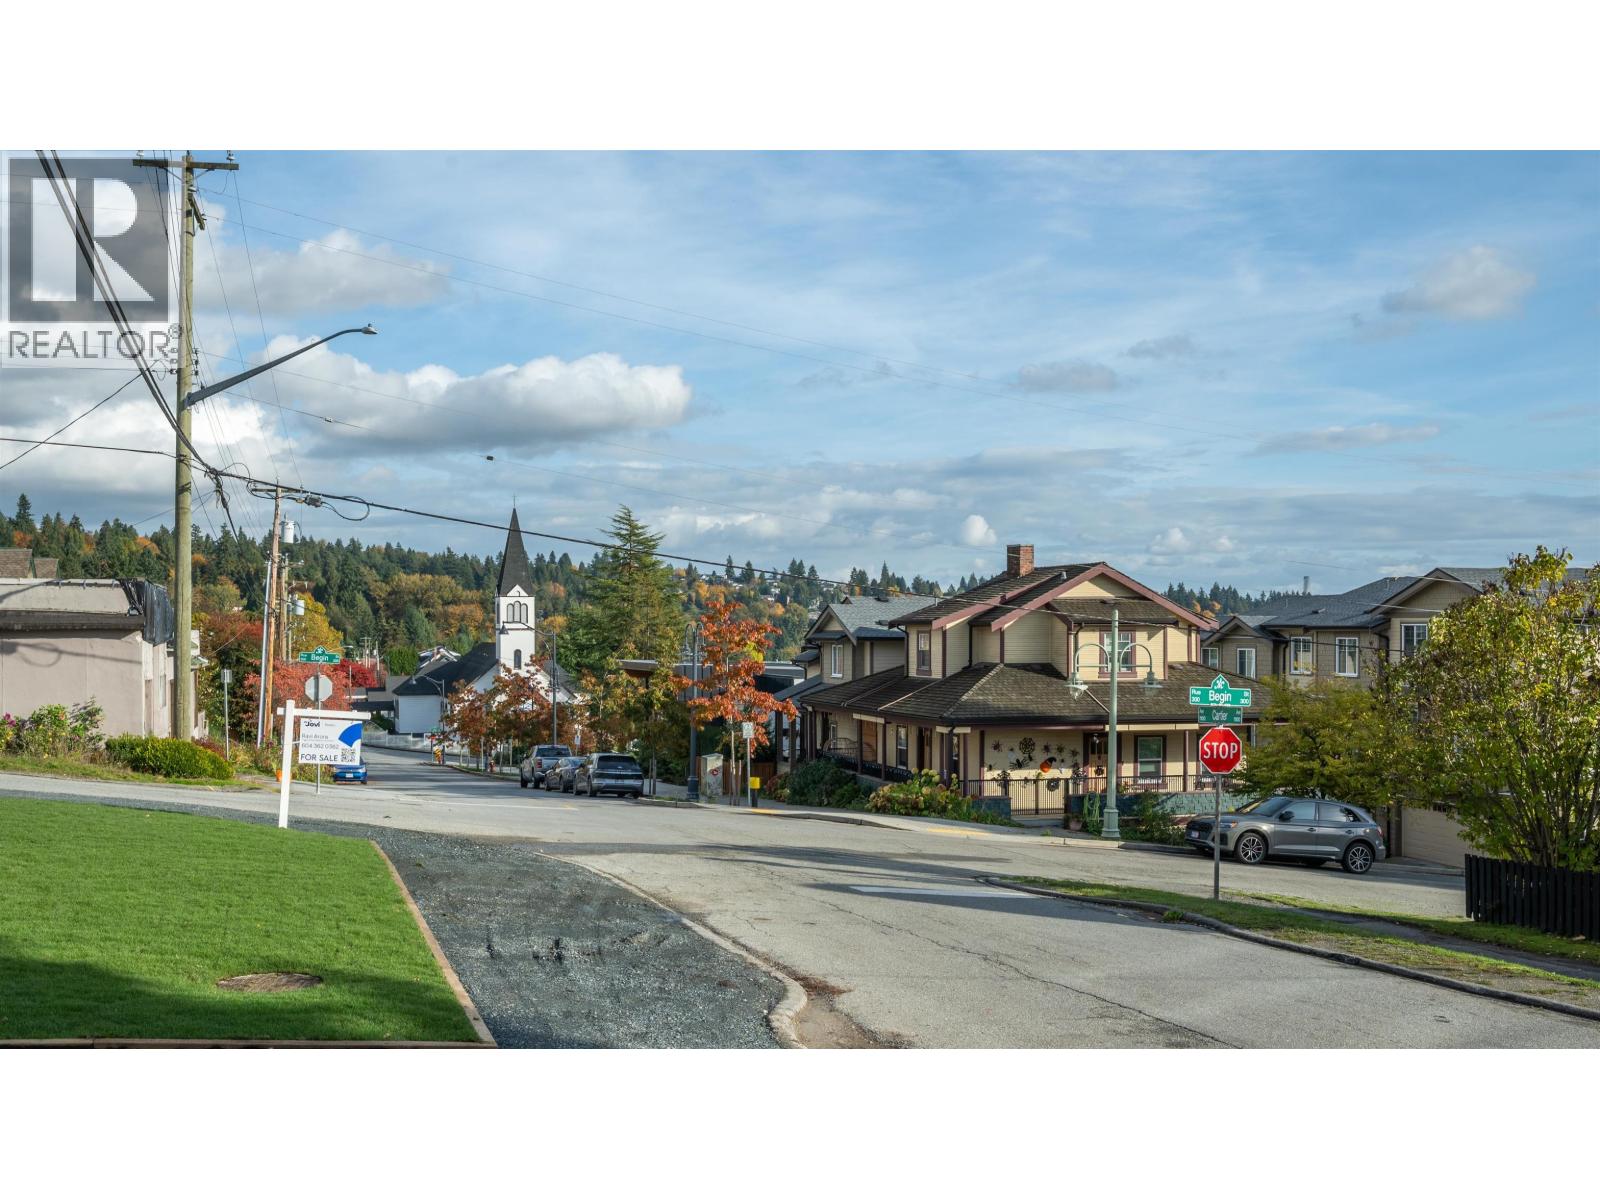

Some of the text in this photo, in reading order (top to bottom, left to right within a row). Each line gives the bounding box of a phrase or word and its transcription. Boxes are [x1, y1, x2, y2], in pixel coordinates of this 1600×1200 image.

[311, 653, 329, 662] Begin
[1209, 690, 1232, 704] Begin
[1211, 709, 1228, 721] Cartier
[1203, 742, 1238, 759] STOP
[300, 753, 339, 762] FOR SALE
